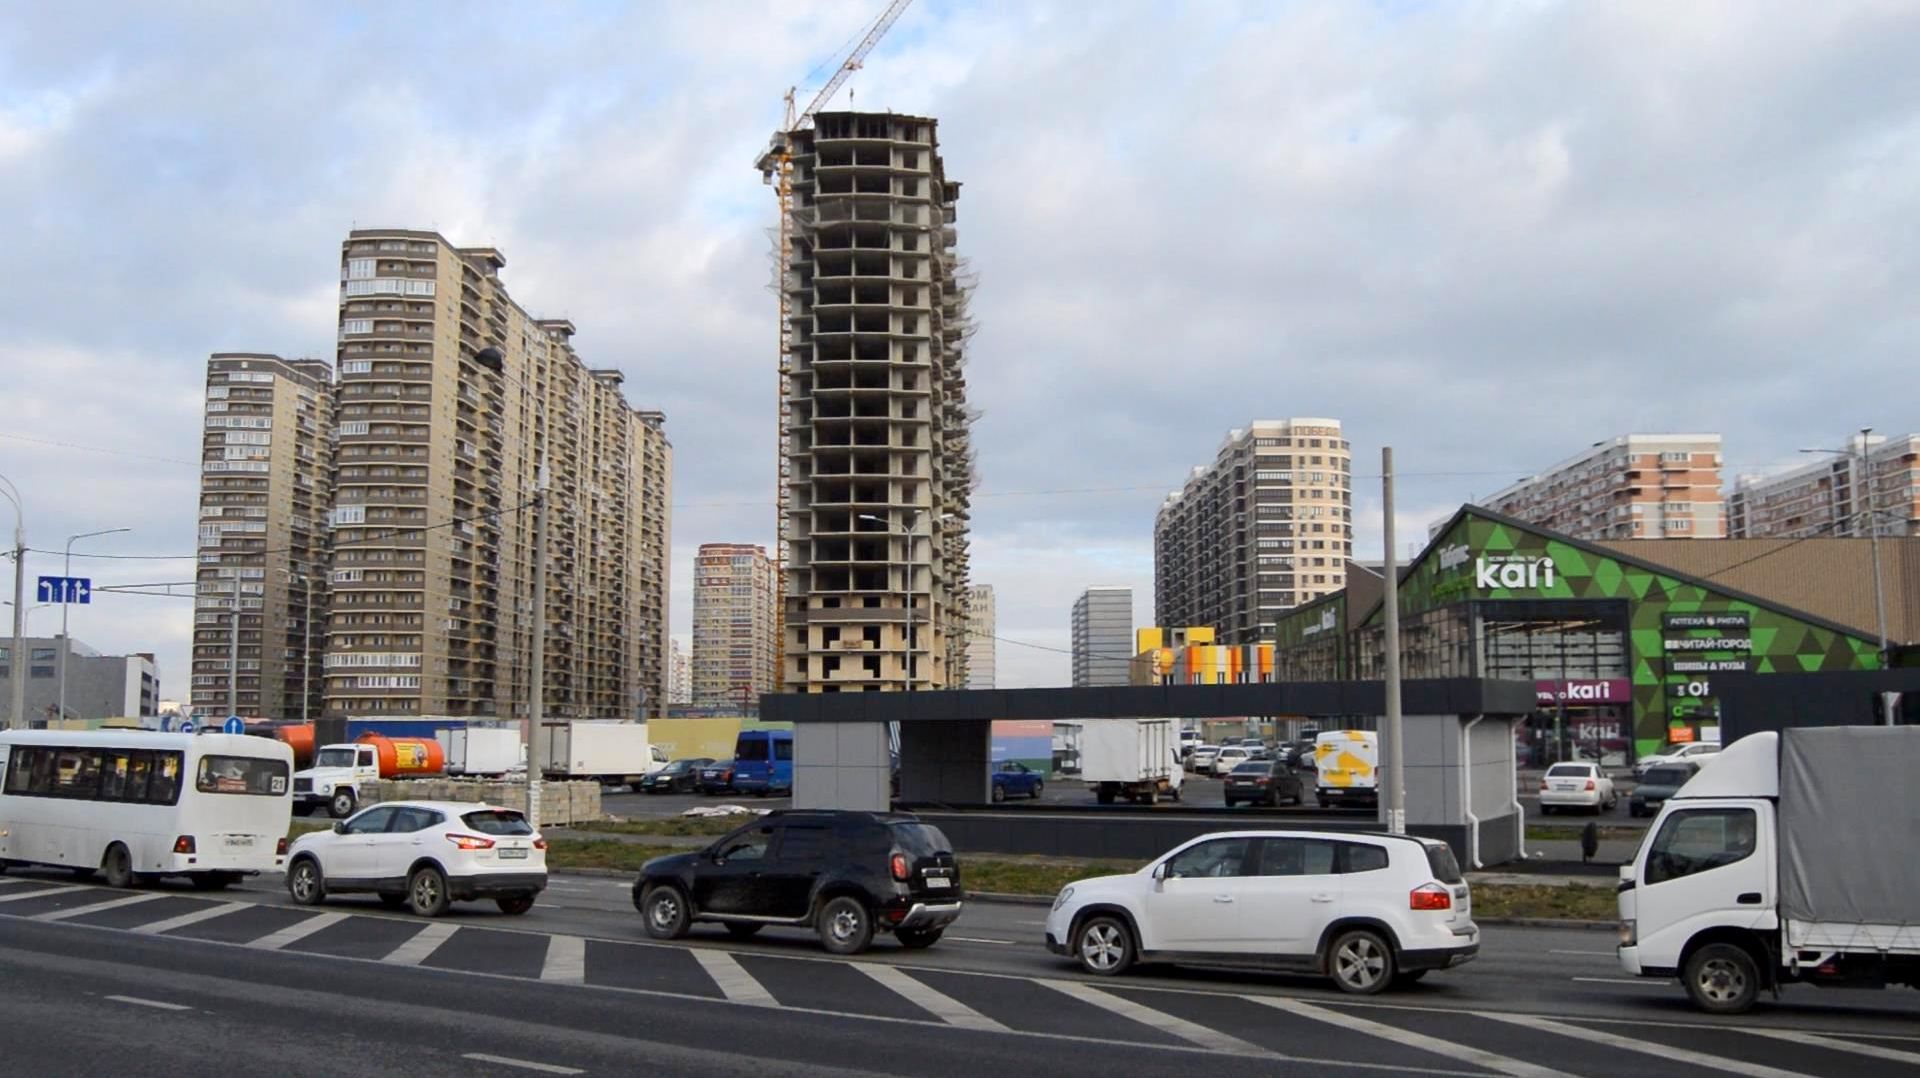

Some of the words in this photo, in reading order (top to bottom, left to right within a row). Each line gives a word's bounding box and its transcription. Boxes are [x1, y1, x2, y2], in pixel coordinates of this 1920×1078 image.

[1476, 557, 1554, 588] kari
[1679, 637, 1752, 649] ЧИТАЙ-ГОРОД
[1567, 681, 1610, 698] kari
